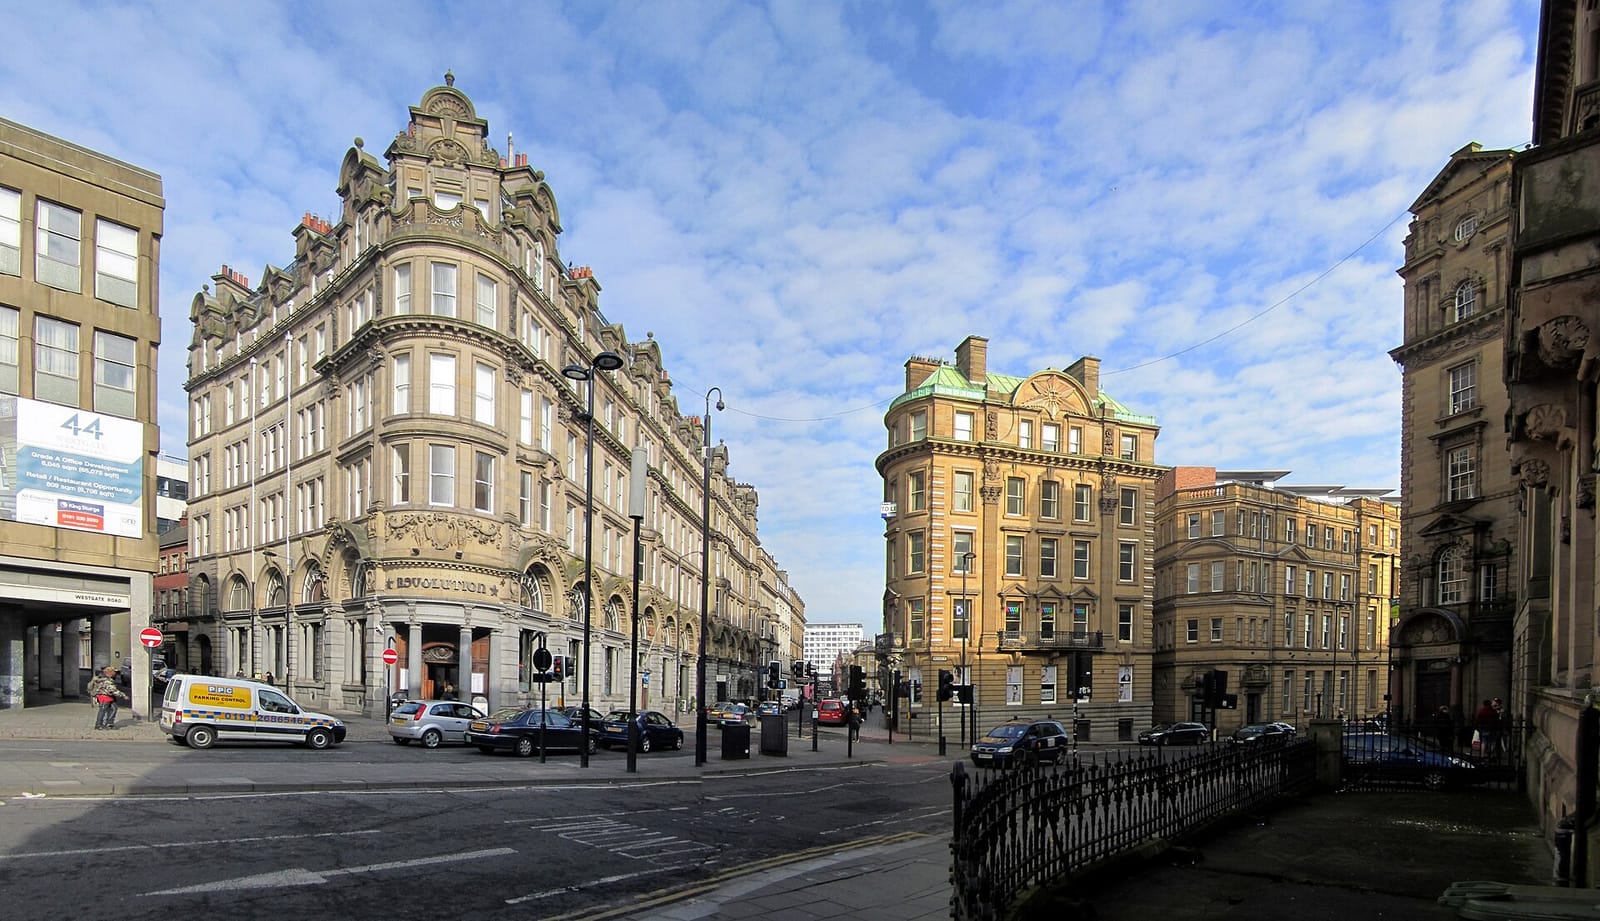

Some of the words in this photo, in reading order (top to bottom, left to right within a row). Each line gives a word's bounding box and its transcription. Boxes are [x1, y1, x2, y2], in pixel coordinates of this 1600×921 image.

[60, 413, 104, 440] 44
[31, 451, 53, 461] Grade
[62, 456, 83, 466] Office
[84, 461, 128, 474] Development
[26, 471, 48, 480] Retail
[54, 475, 92, 488] Restaurant
[93, 482, 134, 495] Opportunity
[75, 594, 105, 602] WESTGATE
[208, 686, 233, 695] PPC
[225, 712, 251, 722] 0191
